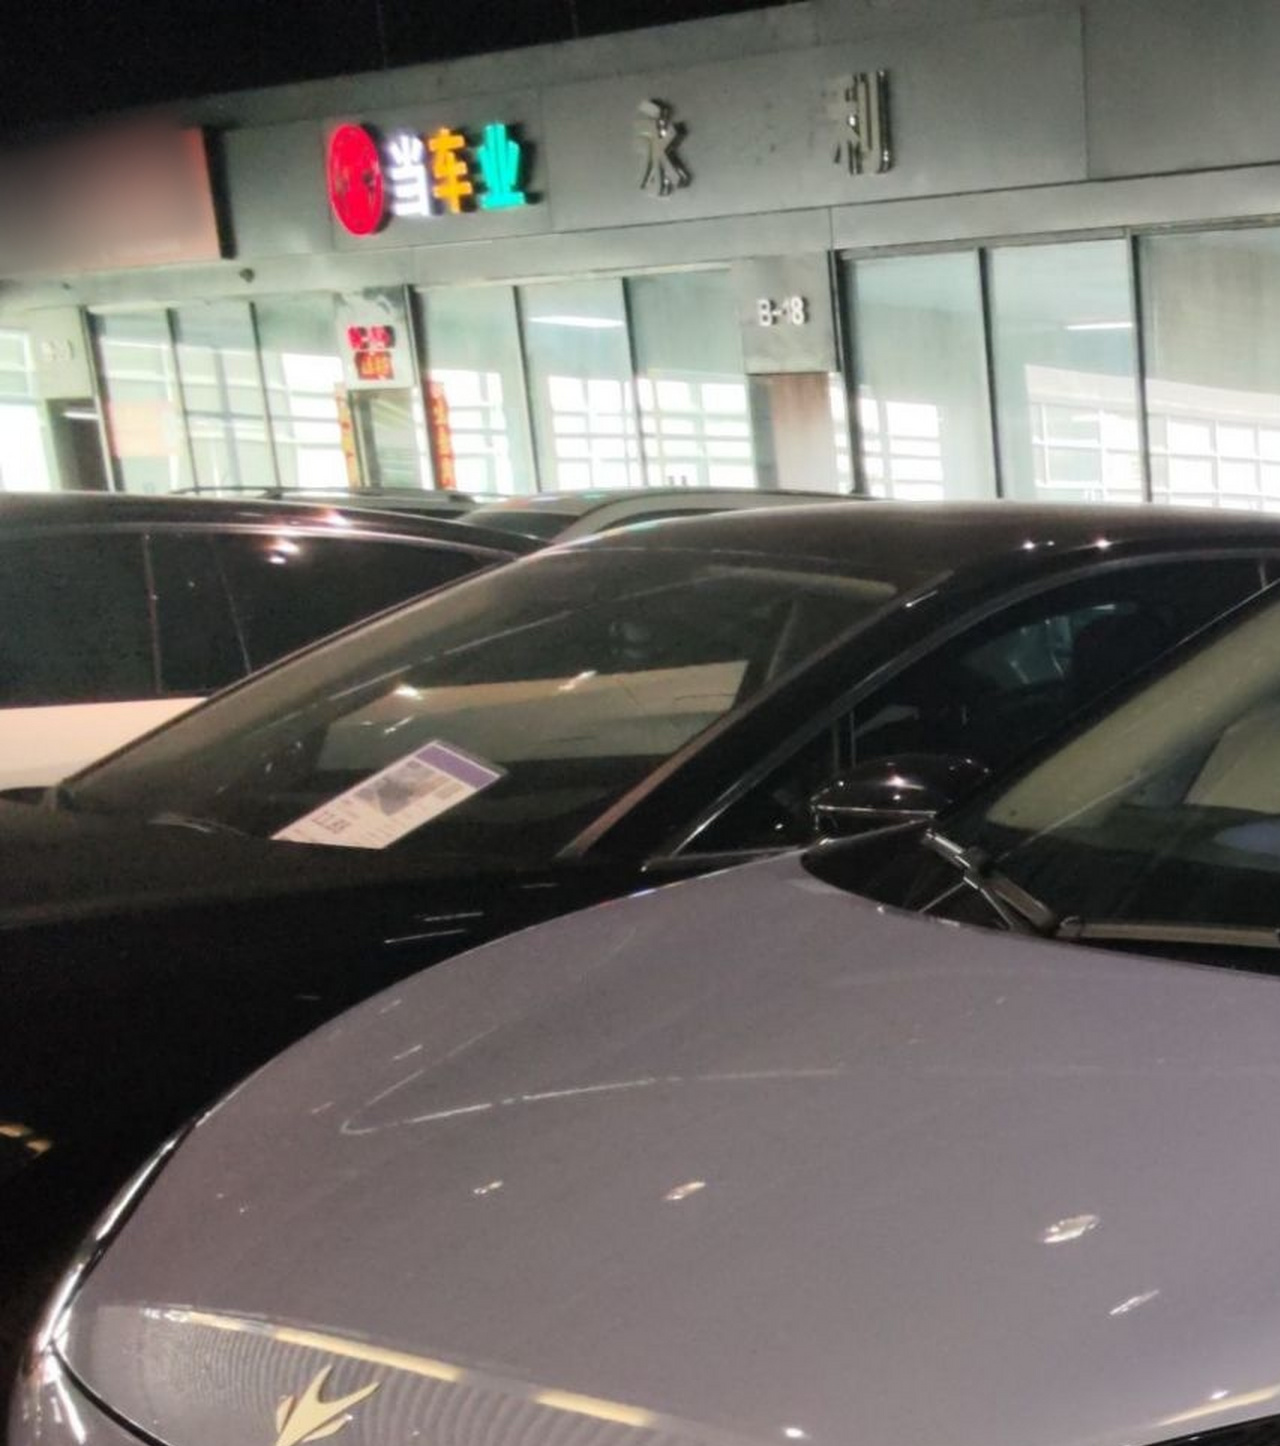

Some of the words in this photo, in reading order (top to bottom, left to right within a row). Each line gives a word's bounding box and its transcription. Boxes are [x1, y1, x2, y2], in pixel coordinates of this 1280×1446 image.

[386, 122, 526, 216] 当车业
[757, 296, 806, 328] B-18
